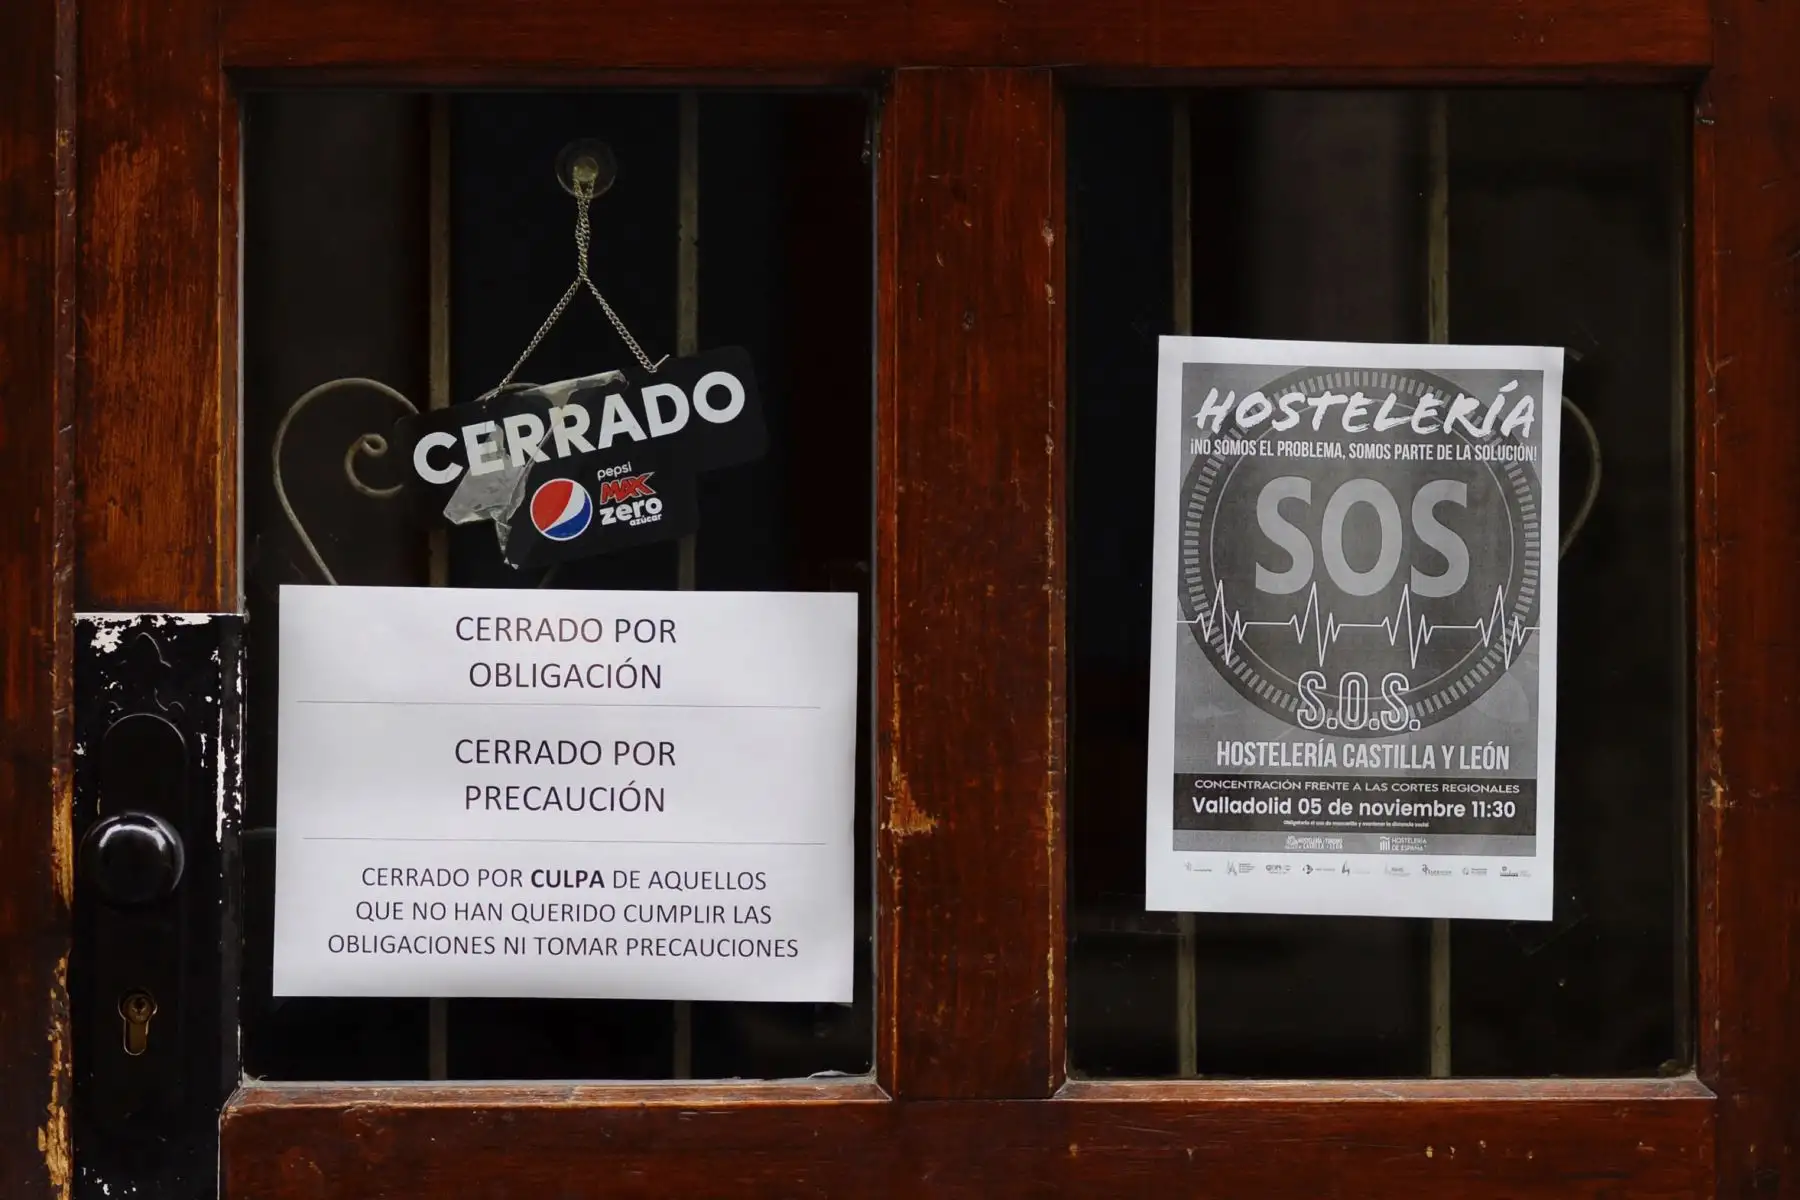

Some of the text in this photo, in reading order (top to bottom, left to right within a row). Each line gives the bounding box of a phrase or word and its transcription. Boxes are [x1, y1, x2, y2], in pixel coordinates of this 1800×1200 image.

[1193, 380, 1536, 439] HOSTELERÍA
[413, 371, 746, 485] CERRADO
[1190, 438, 1538, 462] ¡NO SOMOS EL PROBLEMA, SOMOS PARTE DE LA SOLUCIÓN!
[597, 461, 632, 481] pepsi
[600, 472, 656, 505] MAX
[599, 497, 663, 525] zero
[629, 514, 662, 526] azúcar
[1255, 476, 1470, 598] SOS
[455, 617, 678, 645] CERRADO POR
[469, 657, 663, 690] OBLIGACIÓN
[1297, 670, 1421, 732] S.O.S.
[454, 739, 677, 767] CERRADO POR
[1217, 738, 1510, 771] HOSTELERÍA CASTILLA Y LEÓN
[465, 780, 666, 813] PRECAUCIÓN
[1195, 778, 1521, 794] CONCENTRACIÓN FRENTE A LAS CORTES REGIONALES
[1192, 796, 1516, 819] Valladolid 05 de noviembre 11:30
[361, 867, 768, 894] CERRADO POR CULPA DE AQUELLOS
[355, 901, 773, 927] QUE NO HAN QUERIDO CUMPLIR LAS
[327, 934, 799, 960] OBLIGACIONES NI TOMAR PRECAUCIONES
